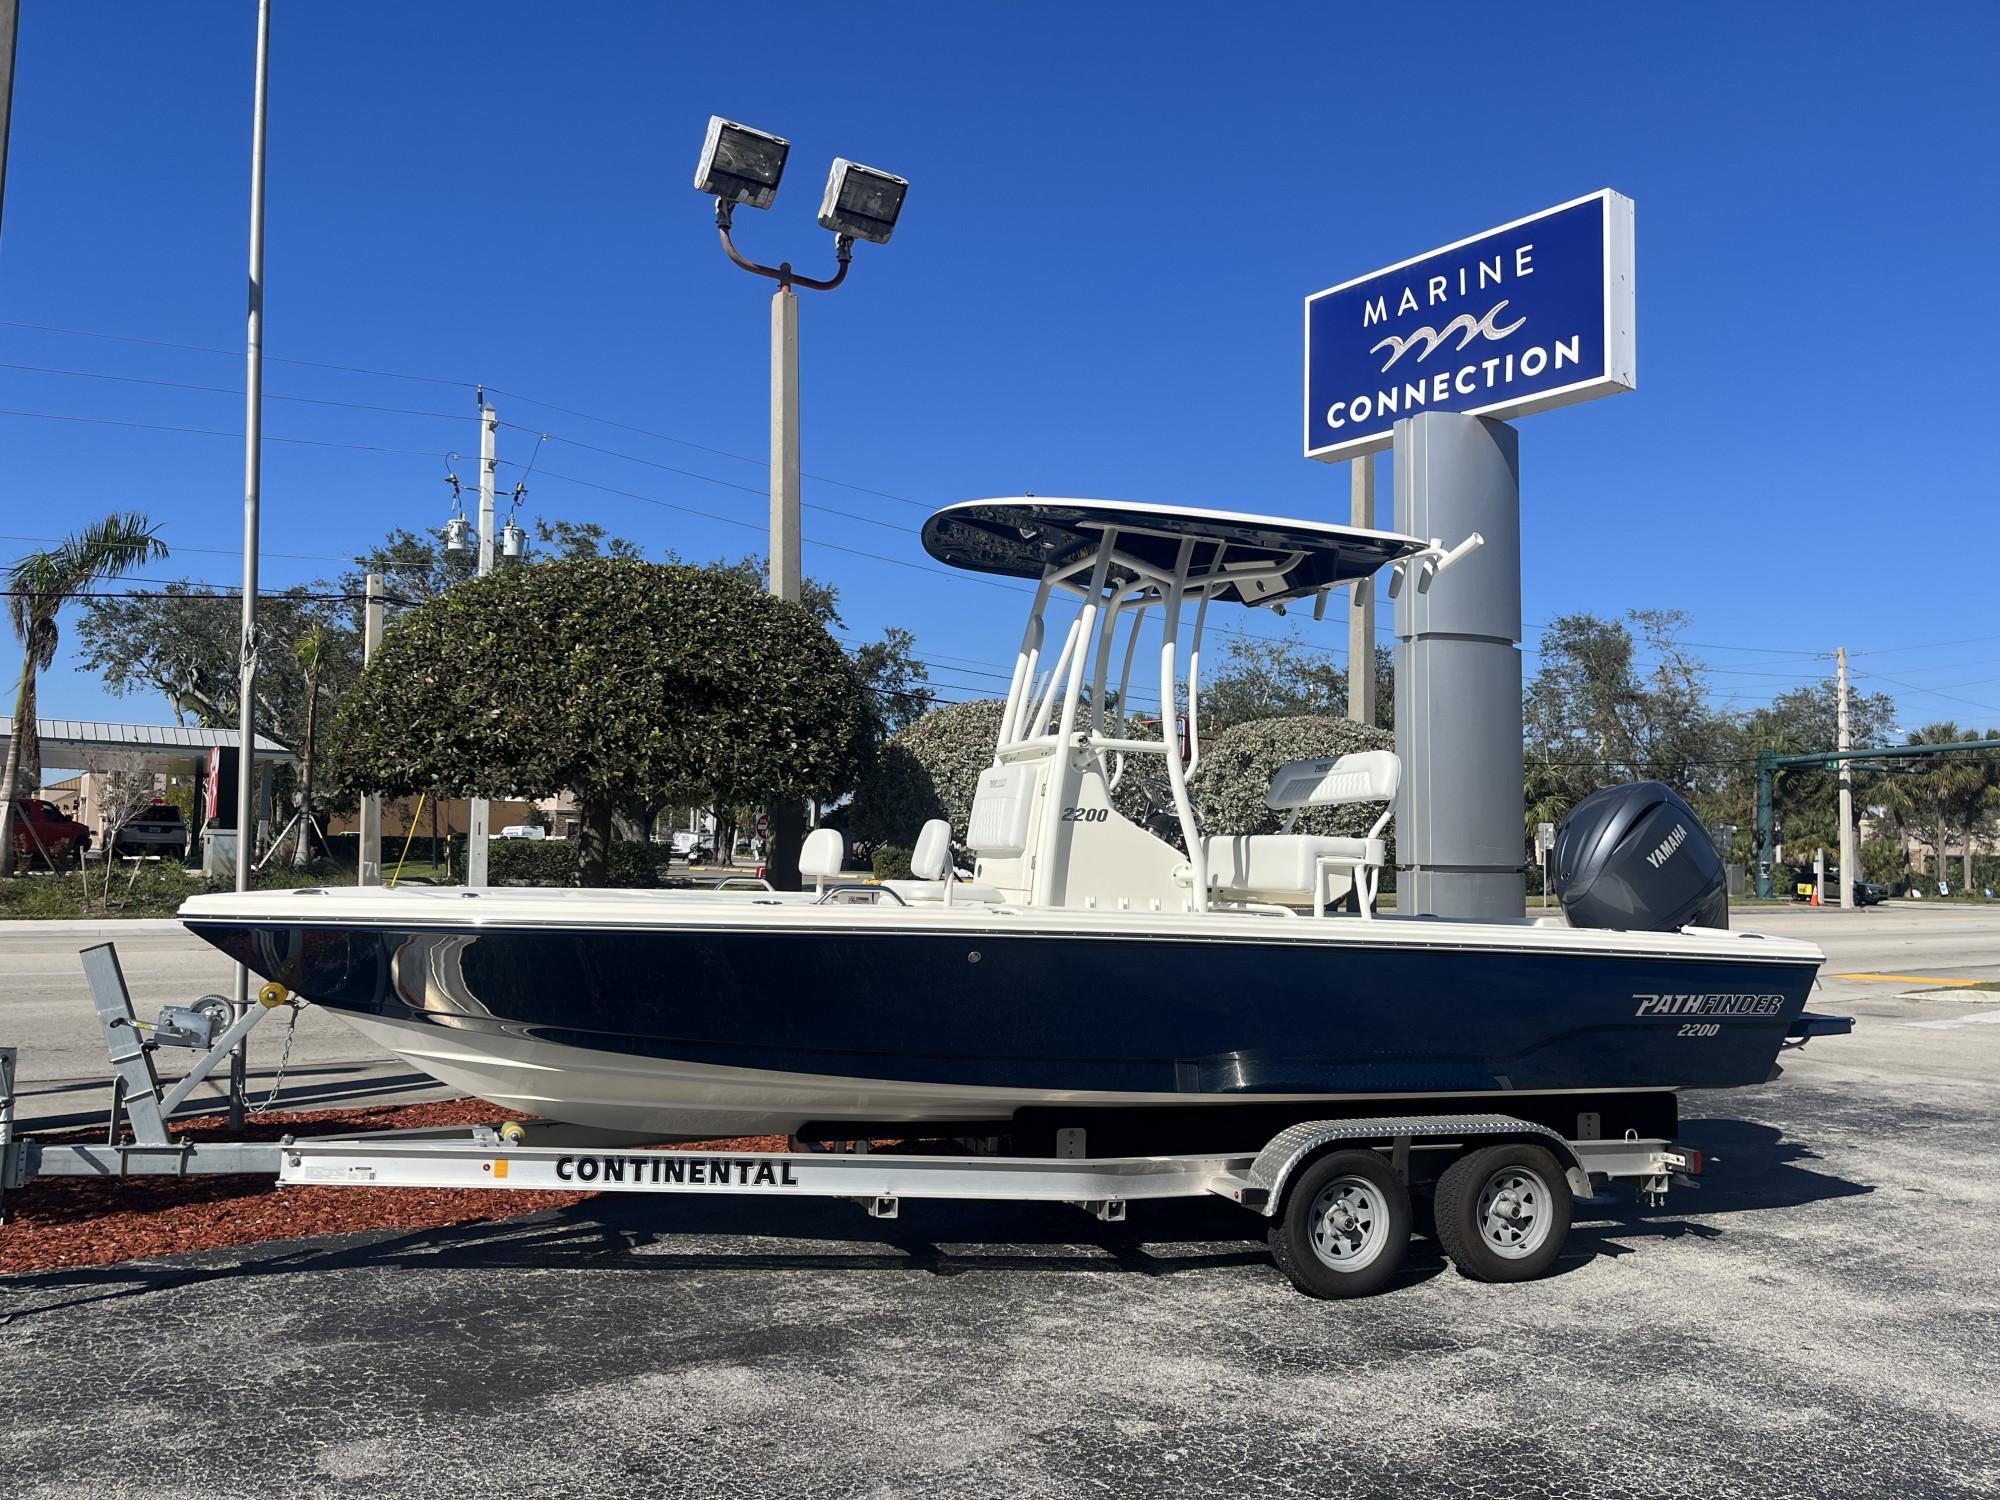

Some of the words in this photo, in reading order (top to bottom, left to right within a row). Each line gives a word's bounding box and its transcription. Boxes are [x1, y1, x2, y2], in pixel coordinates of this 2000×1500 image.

[1363, 245, 1535, 327] MARINE
[1326, 335, 1580, 429] CONNECTION
[1062, 807, 1109, 822] 2200
[1646, 824, 1687, 869] YAMAHA
[1632, 994, 1785, 1017] PATHFINDER
[1677, 1023, 1720, 1037] 2200
[555, 1155, 798, 1187] CONTINENTAL
